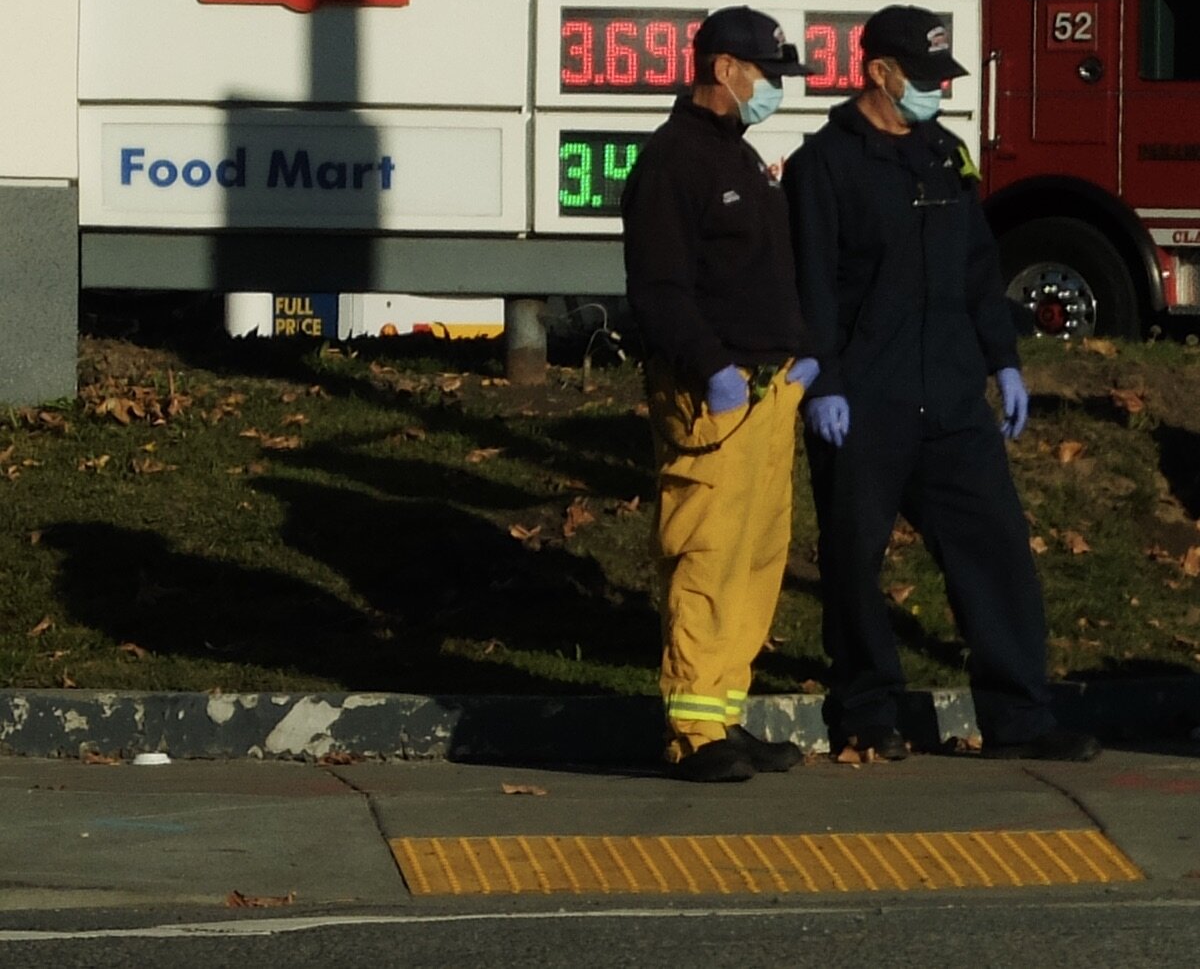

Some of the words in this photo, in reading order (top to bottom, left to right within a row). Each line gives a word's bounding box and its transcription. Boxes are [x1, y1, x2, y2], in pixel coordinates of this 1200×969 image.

[1054, 12, 1092, 41] 52
[120, 147, 246, 188] Food
[266, 149, 396, 190] Mart
[275, 296, 314, 316] FULL
[275, 318, 322, 337] PRICE
